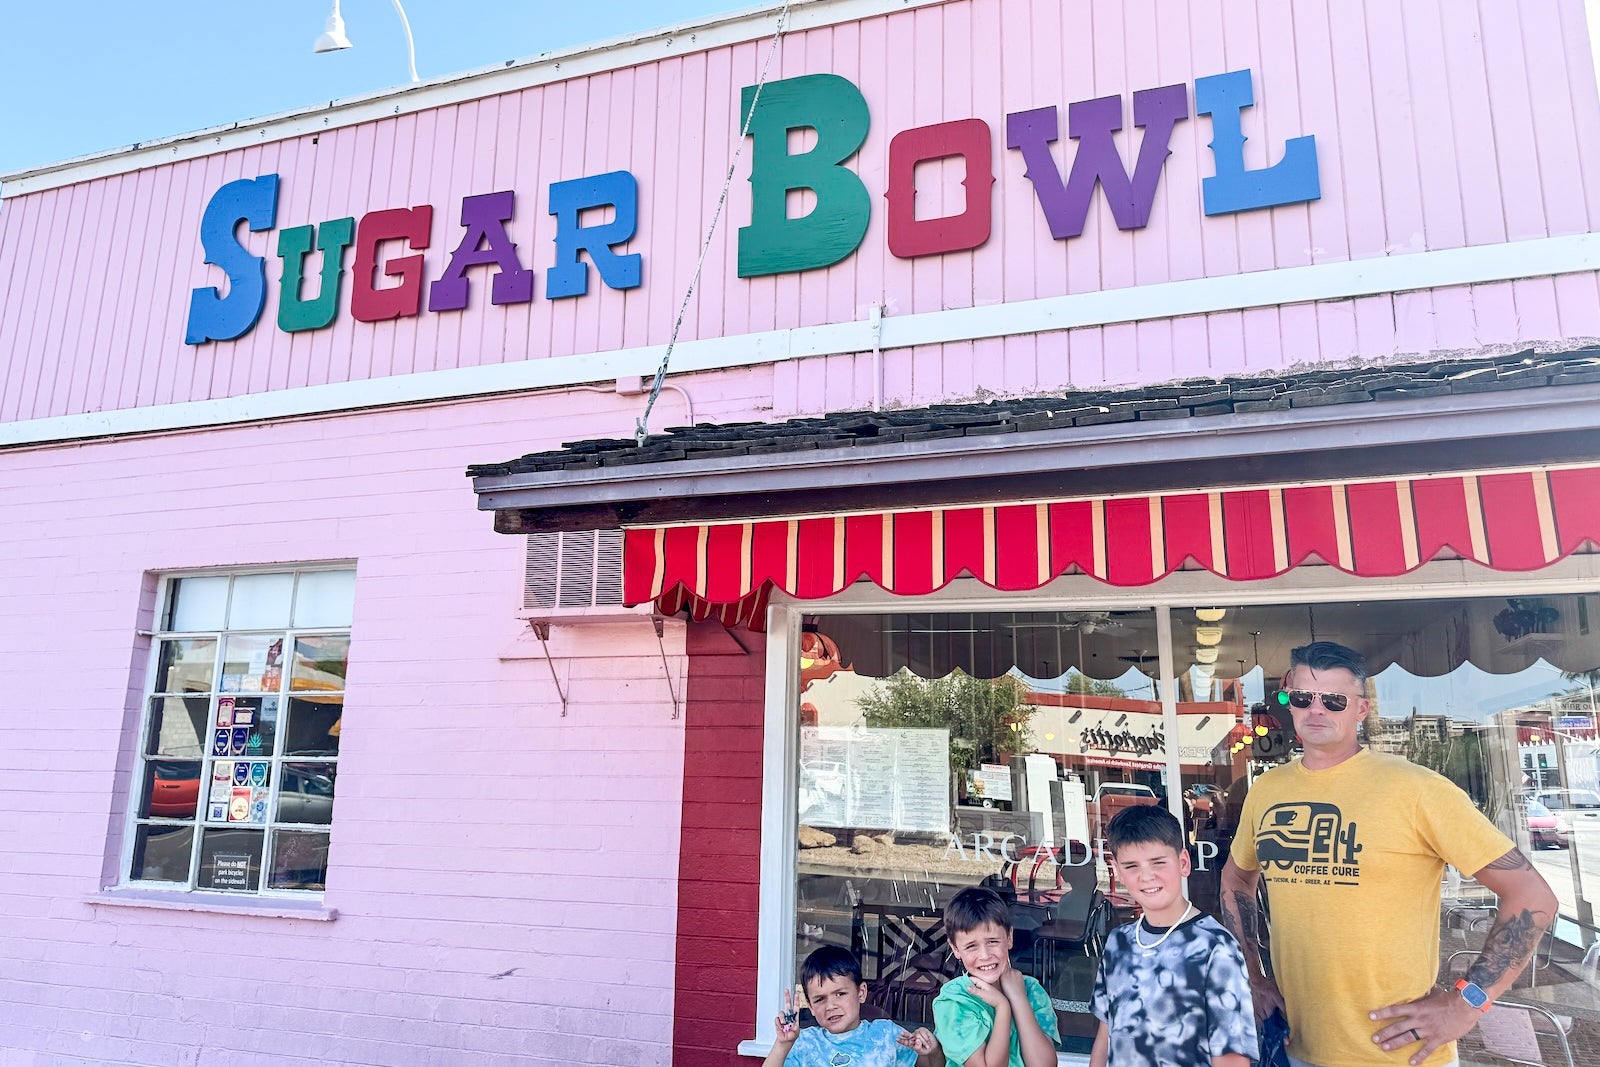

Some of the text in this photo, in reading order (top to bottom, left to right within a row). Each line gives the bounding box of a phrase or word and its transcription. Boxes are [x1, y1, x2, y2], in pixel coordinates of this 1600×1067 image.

[185, 69, 1322, 346] SUGAR BOWL
[1294, 865, 1360, 877] COFFEE CURE
